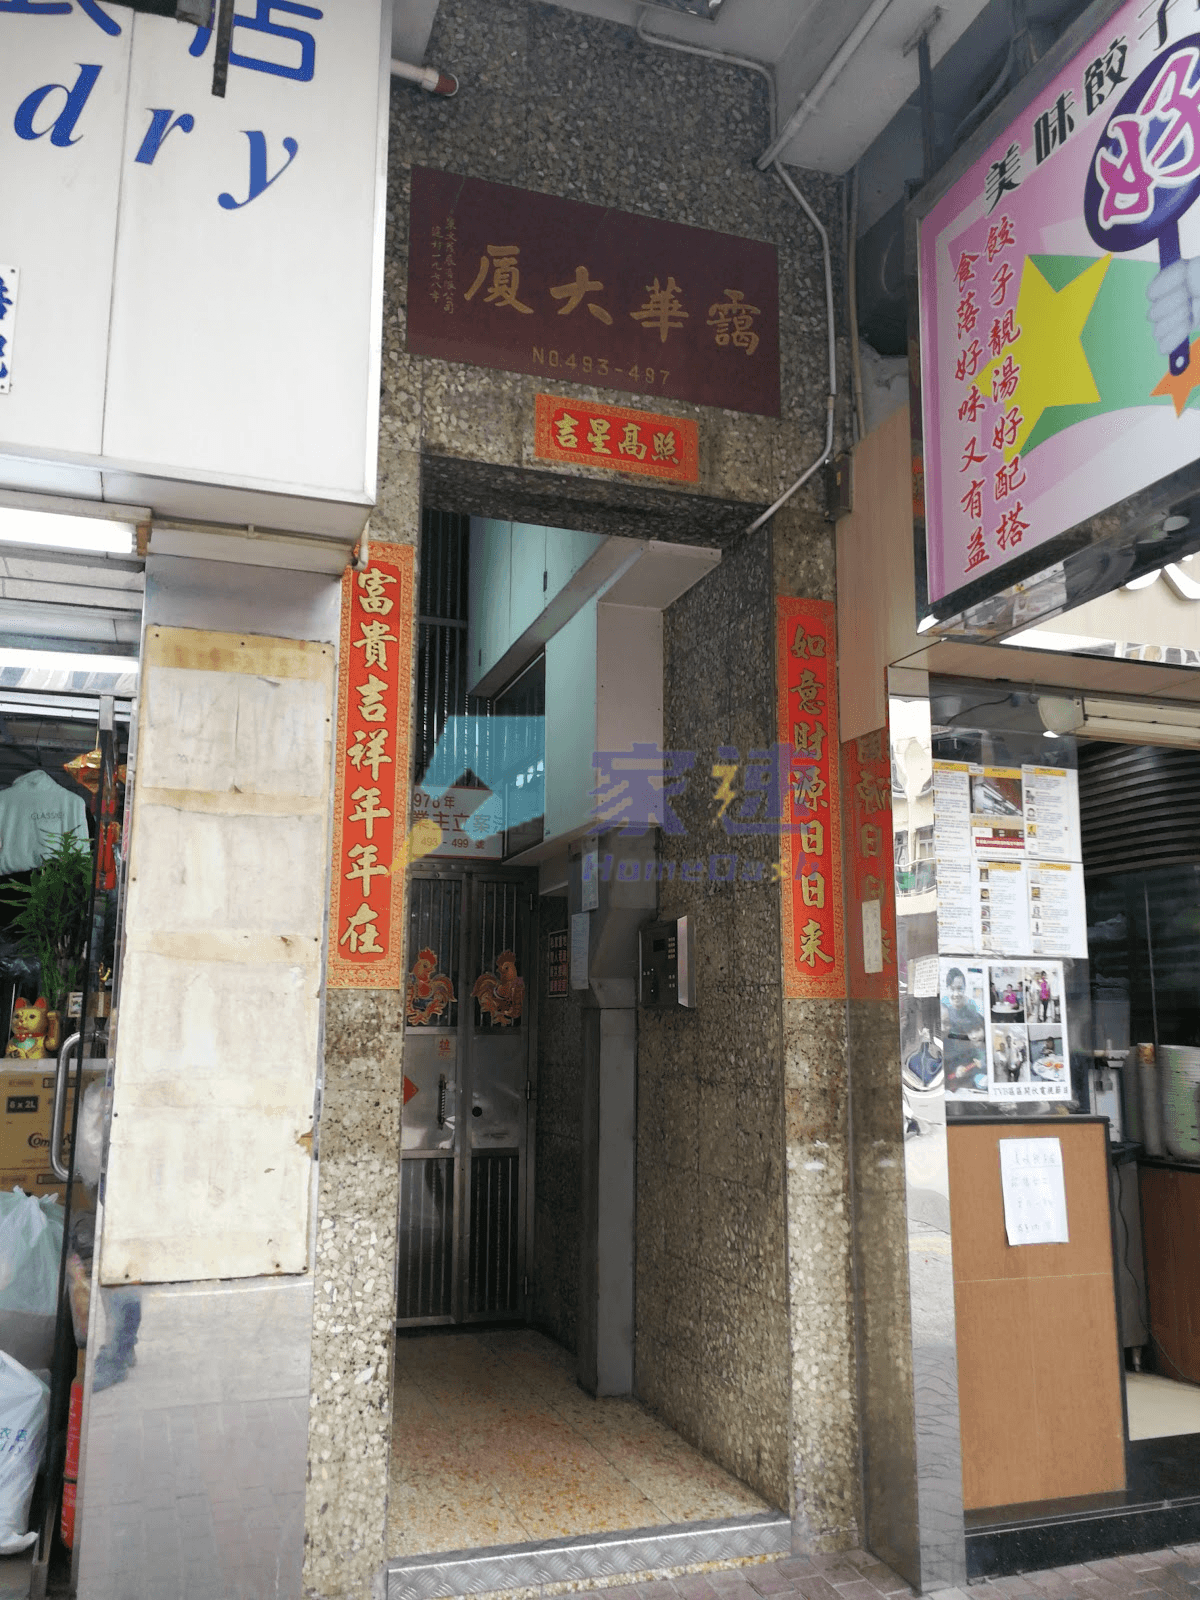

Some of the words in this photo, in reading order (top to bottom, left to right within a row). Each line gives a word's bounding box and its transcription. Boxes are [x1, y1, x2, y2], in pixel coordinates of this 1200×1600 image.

[985, 216, 1032, 551] 餃子靚湯好配搭
[338, 566, 399, 955] 富貴吉祥年年在
